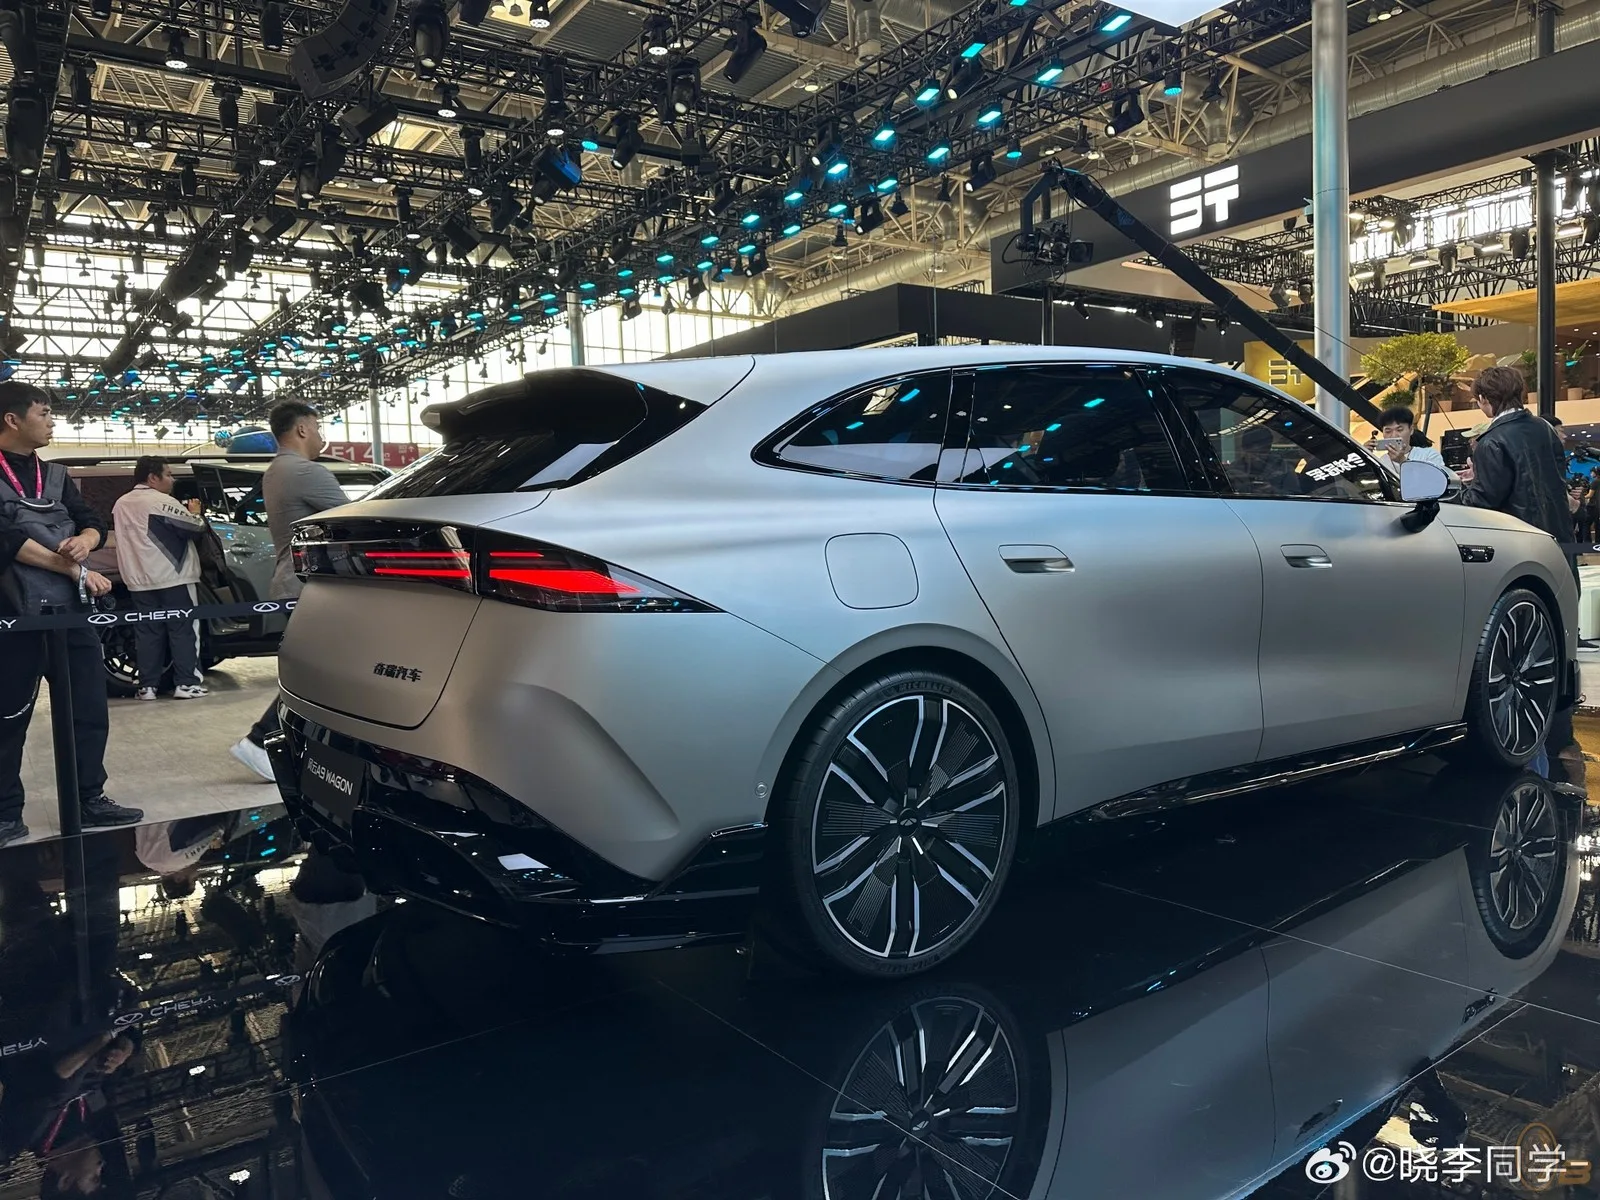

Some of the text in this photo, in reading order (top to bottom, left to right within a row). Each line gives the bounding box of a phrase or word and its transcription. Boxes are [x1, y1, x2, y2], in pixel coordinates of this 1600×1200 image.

[124, 608, 193, 622] CHERY
[373, 661, 423, 682] 奇瑞汽车
[325, 769, 354, 796] WAGON
